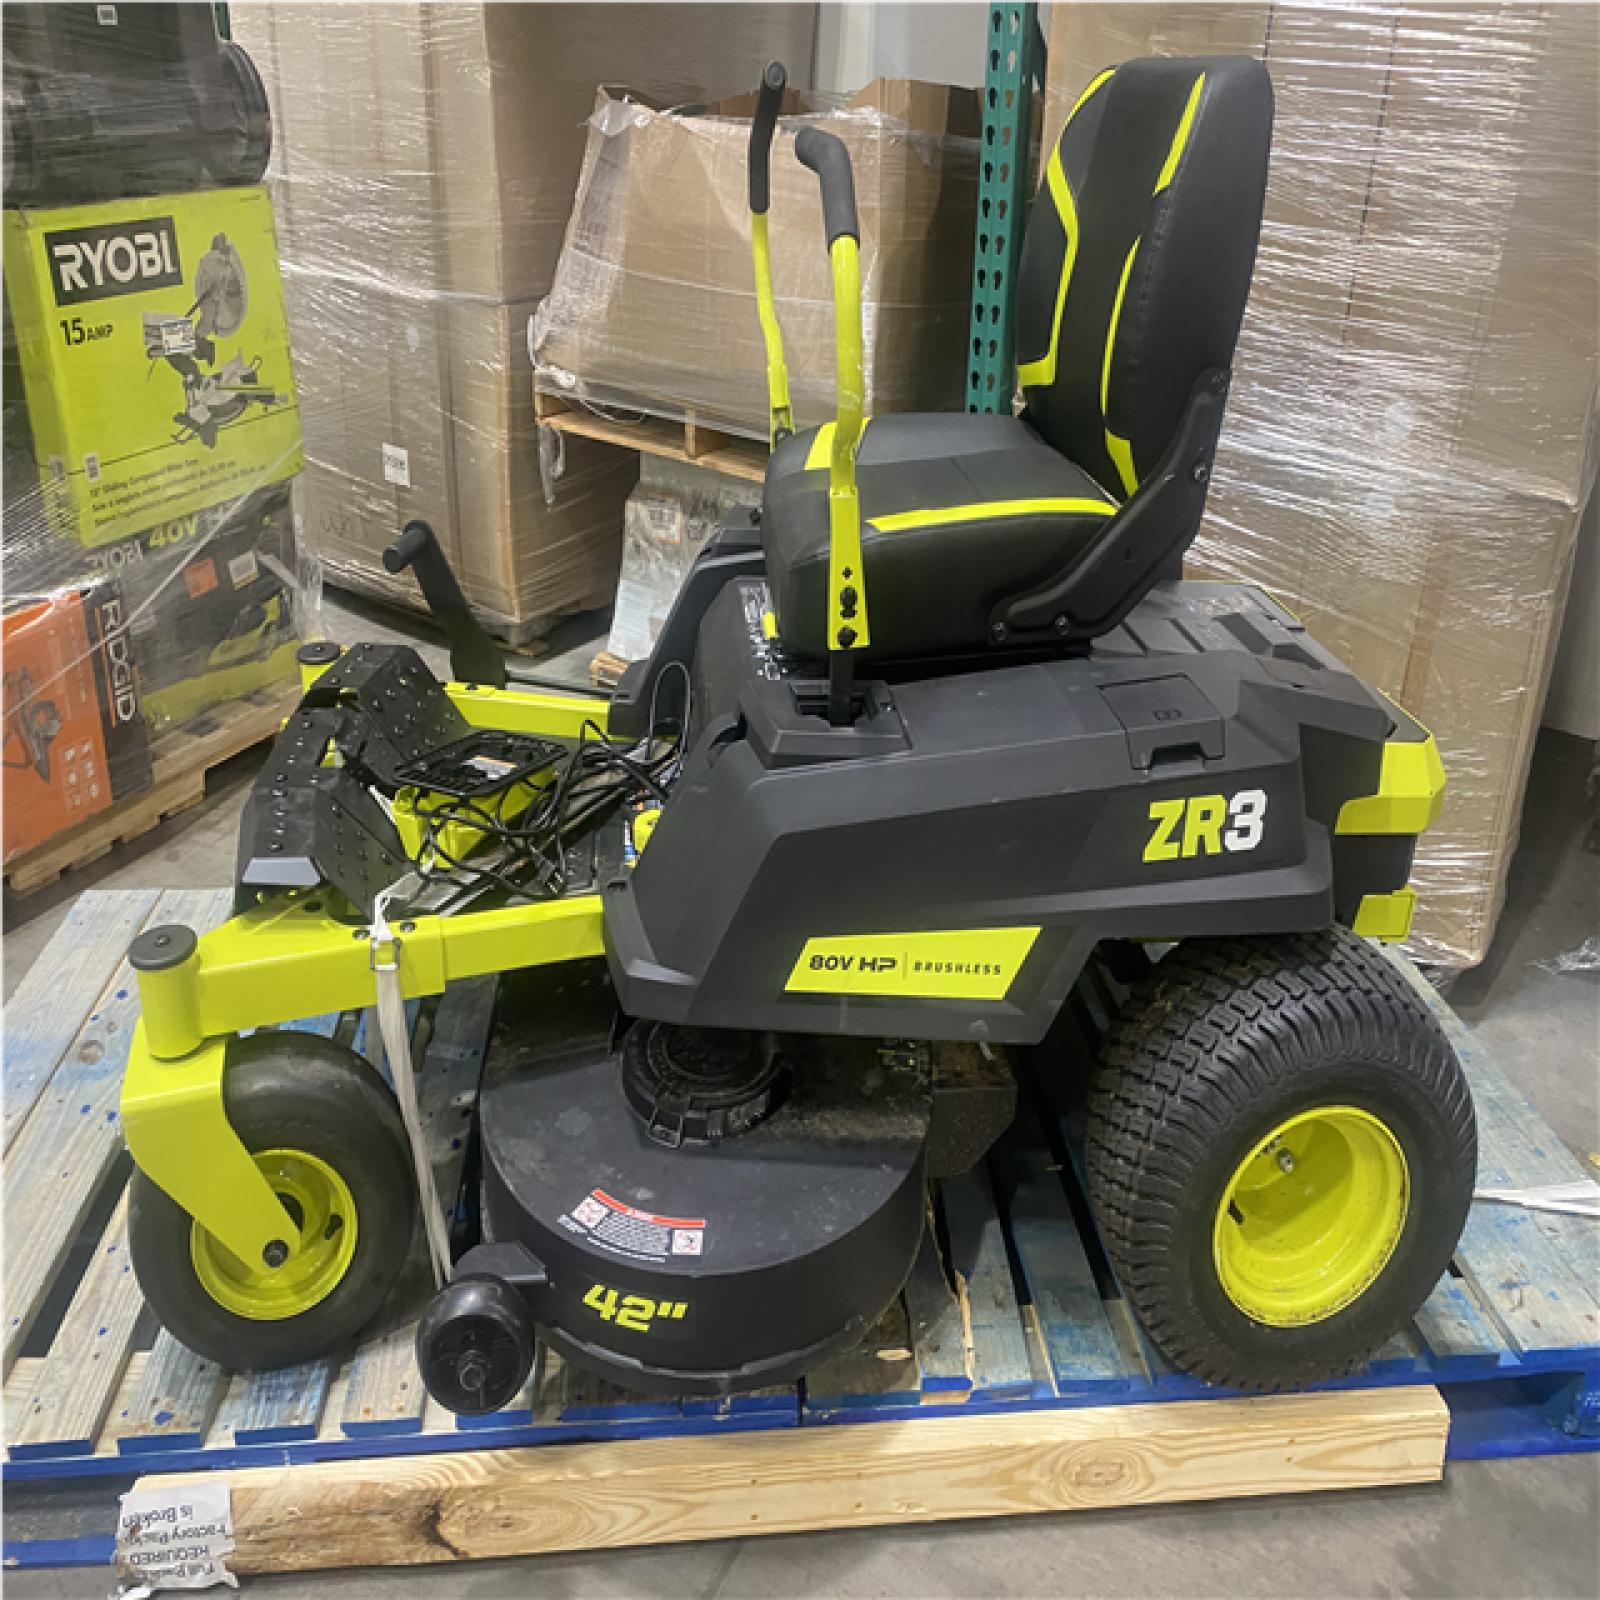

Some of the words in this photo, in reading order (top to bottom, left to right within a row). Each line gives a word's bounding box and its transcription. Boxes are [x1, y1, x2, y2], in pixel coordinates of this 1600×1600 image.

[54, 230, 175, 291] RYOBI
[60, 317, 86, 345] 15
[87, 324, 113, 342] AMP
[148, 515, 197, 548] 40V
[102, 600, 135, 720] RDGID
[1142, 790, 1268, 862] ZR3
[809, 953, 854, 971] 80V
[858, 956, 898, 972] HP
[914, 959, 1001, 976] BRUSHLESS
[582, 1284, 688, 1332] 42"
[130, 1544, 210, 1566] REQUIRED
